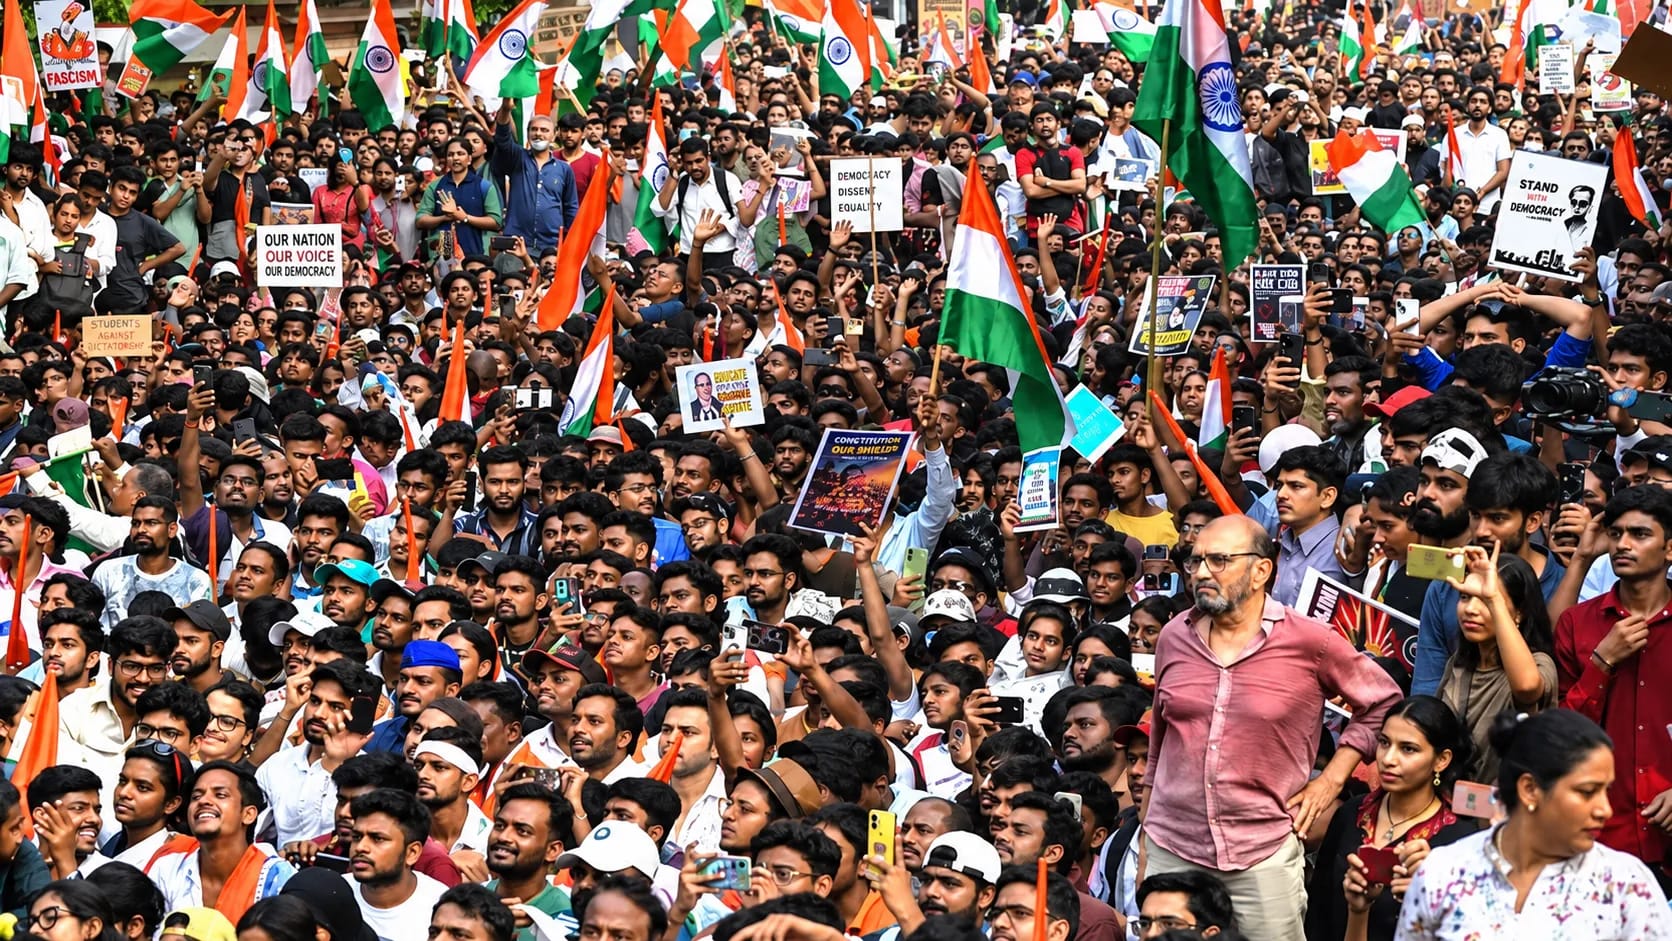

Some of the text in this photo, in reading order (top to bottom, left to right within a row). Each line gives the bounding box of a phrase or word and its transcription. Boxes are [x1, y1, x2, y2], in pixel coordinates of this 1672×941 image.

[46, 70, 97, 86] FASCISM
[1519, 179, 1559, 193] STAND
[1510, 202, 1566, 217] DEMOCRACY
[265, 233, 335, 246] OUR NATION
[266, 250, 335, 262] OUR VOICE
[265, 266, 336, 277] OUR DEMOCRACY
[90, 319, 141, 329] STUDENTS
[98, 331, 135, 340] AGAINST
[831, 445, 855, 454] OUR
